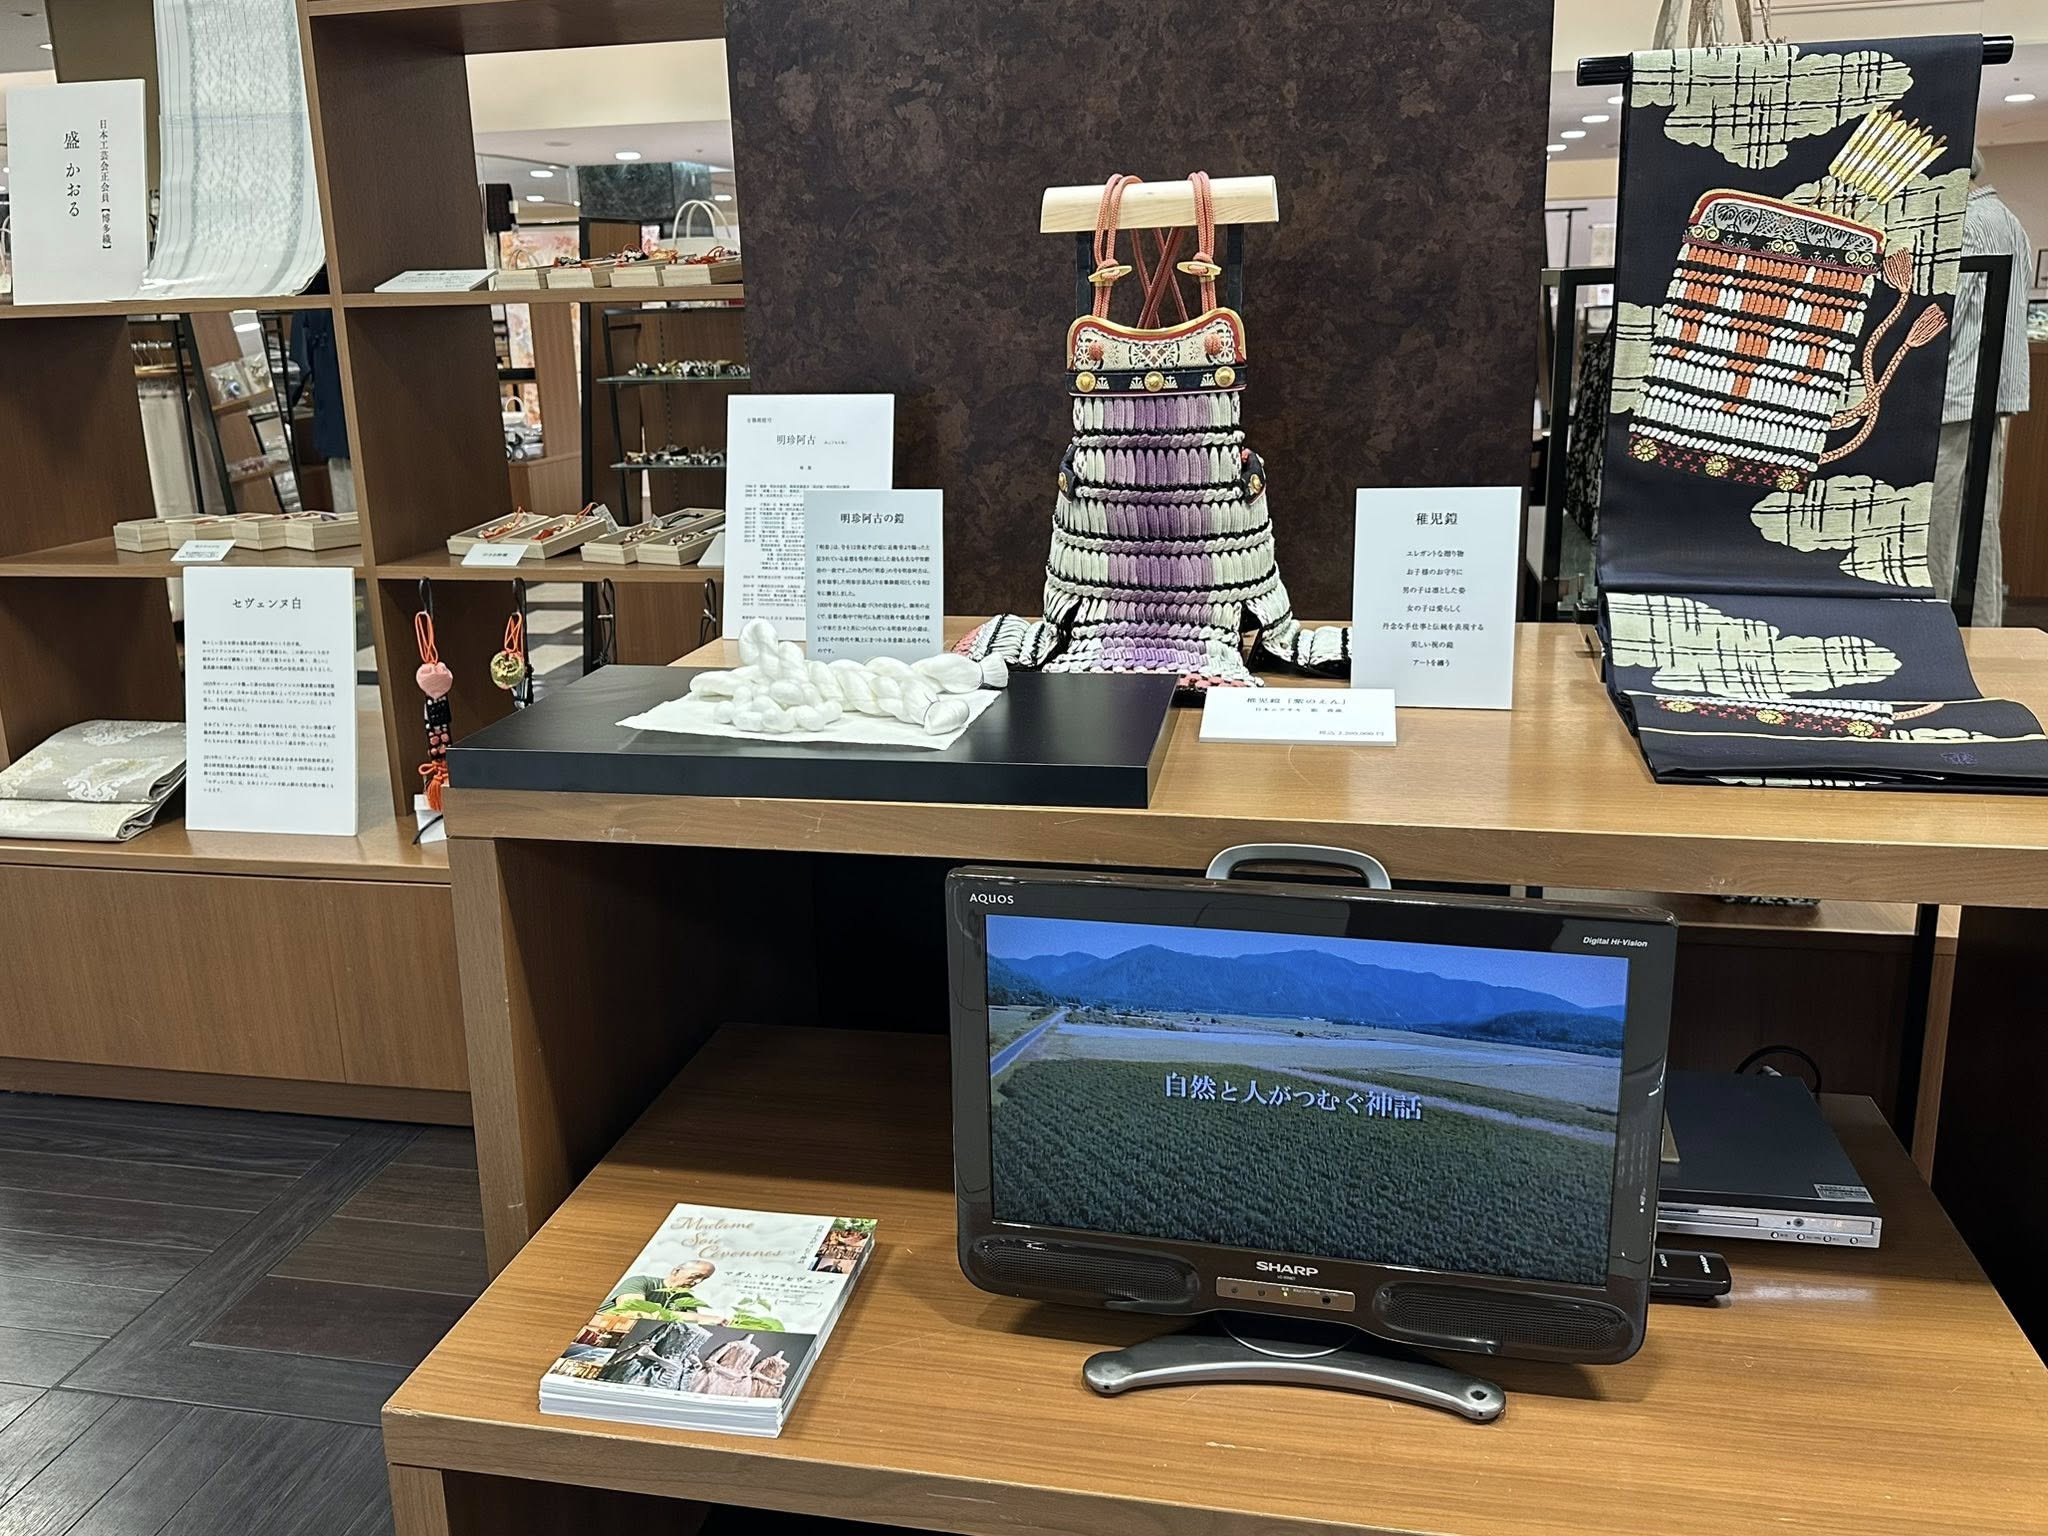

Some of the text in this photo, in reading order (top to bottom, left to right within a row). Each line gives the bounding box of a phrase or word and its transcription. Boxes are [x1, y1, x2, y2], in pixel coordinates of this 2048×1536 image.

[64, 131, 80, 216] 盛 かおる
[777, 435, 816, 445] 明珍阿古
[841, 513, 904, 524] 明珍阿古の鎧
[1416, 513, 1457, 525] 稚児鎧
[1406, 549, 1465, 558] エレガントな贈り物
[1406, 568, 1463, 577] お子様のお守りに
[233, 597, 301, 609] セヴェンヌ白
[1406, 604, 1461, 613] 女の子は愛らしく
[1382, 622, 1484, 632] 丹念な手仕事と伝統を表現する
[970, 893, 1014, 904] AQUOS
[1583, 937, 1648, 947] Digital Hi-Vision
[1164, 1071, 1423, 1121] 自然と人がつむぐ神話
[671, 1216, 754, 1231] Madame
[1256, 1261, 1318, 1276] SHARP
